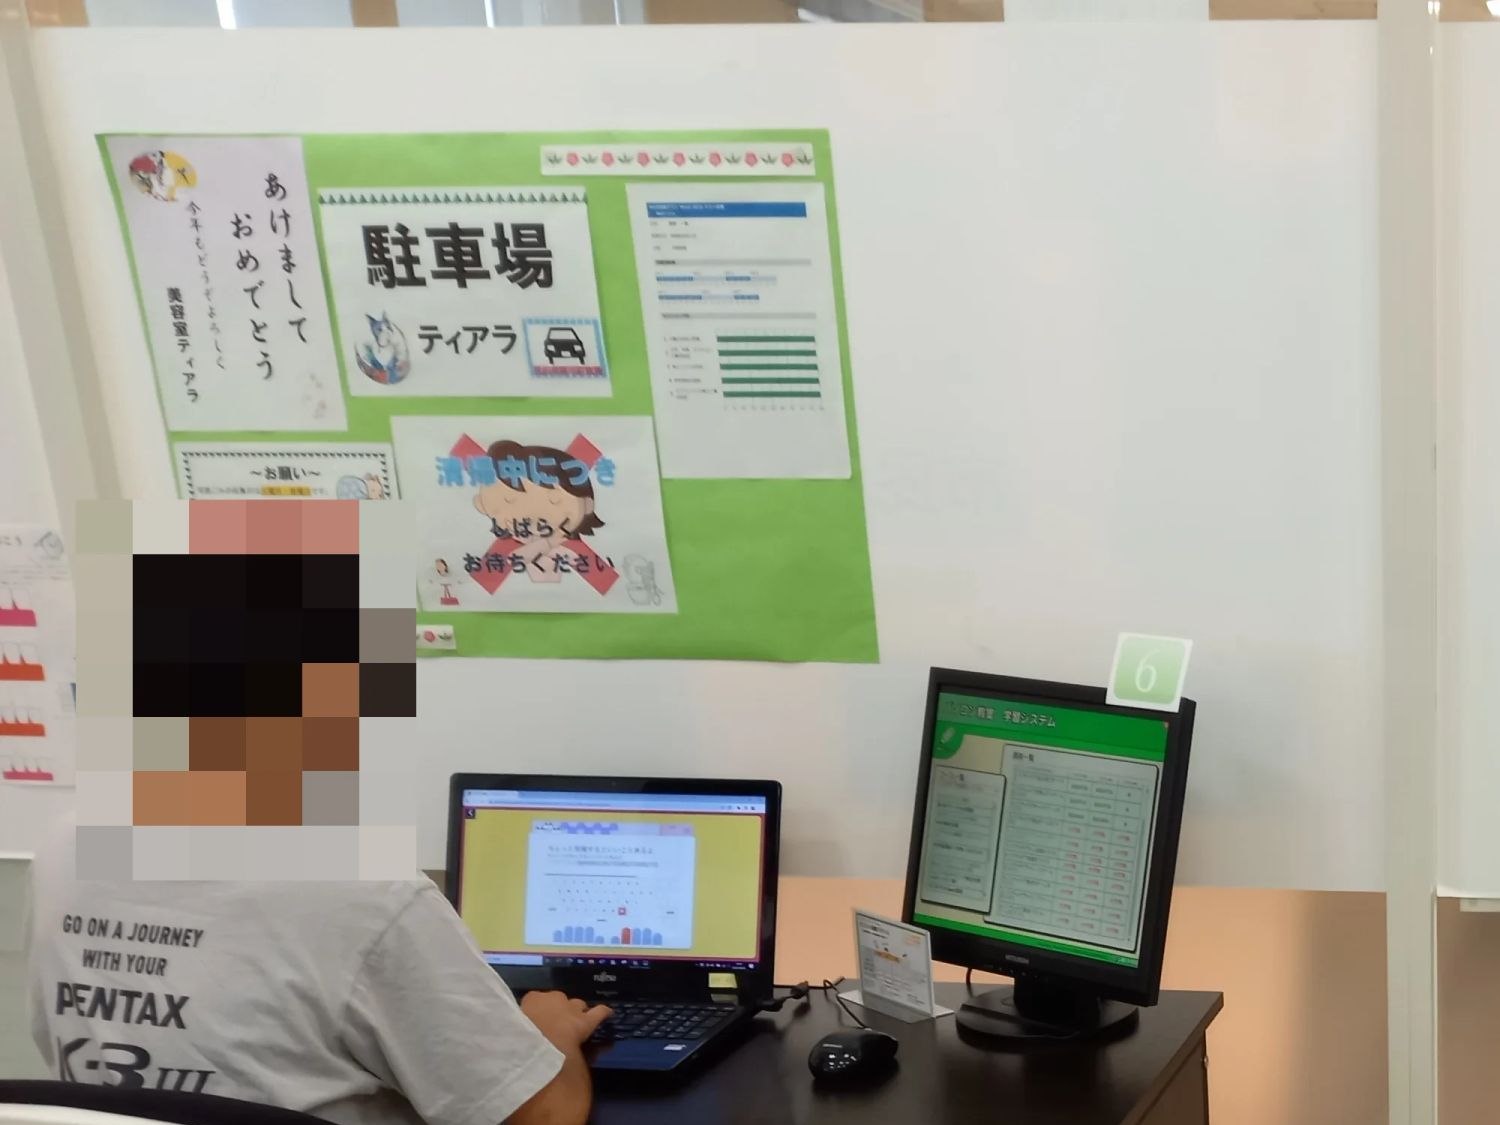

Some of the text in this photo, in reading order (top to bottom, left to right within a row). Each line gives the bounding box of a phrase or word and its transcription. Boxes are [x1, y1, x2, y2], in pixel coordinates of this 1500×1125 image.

[264, 173, 308, 343] あけまして
[361, 221, 553, 289] 駐車場
[230, 213, 274, 380] おめでとう
[166, 287, 198, 402] 美容室ティアラ
[417, 324, 517, 354] ティアラ
[436, 455, 617, 487] 清掃中につき
[490, 517, 575, 538] しばらく
[463, 553, 616, 574] お待ちください
[1135, 648, 1158, 693] 6
[63, 914, 204, 948] GO ON A JOURNEY
[82, 949, 168, 977] WITH YOUR
[56, 981, 191, 1030] PENTAX
[56, 1037, 151, 1090] K-3
